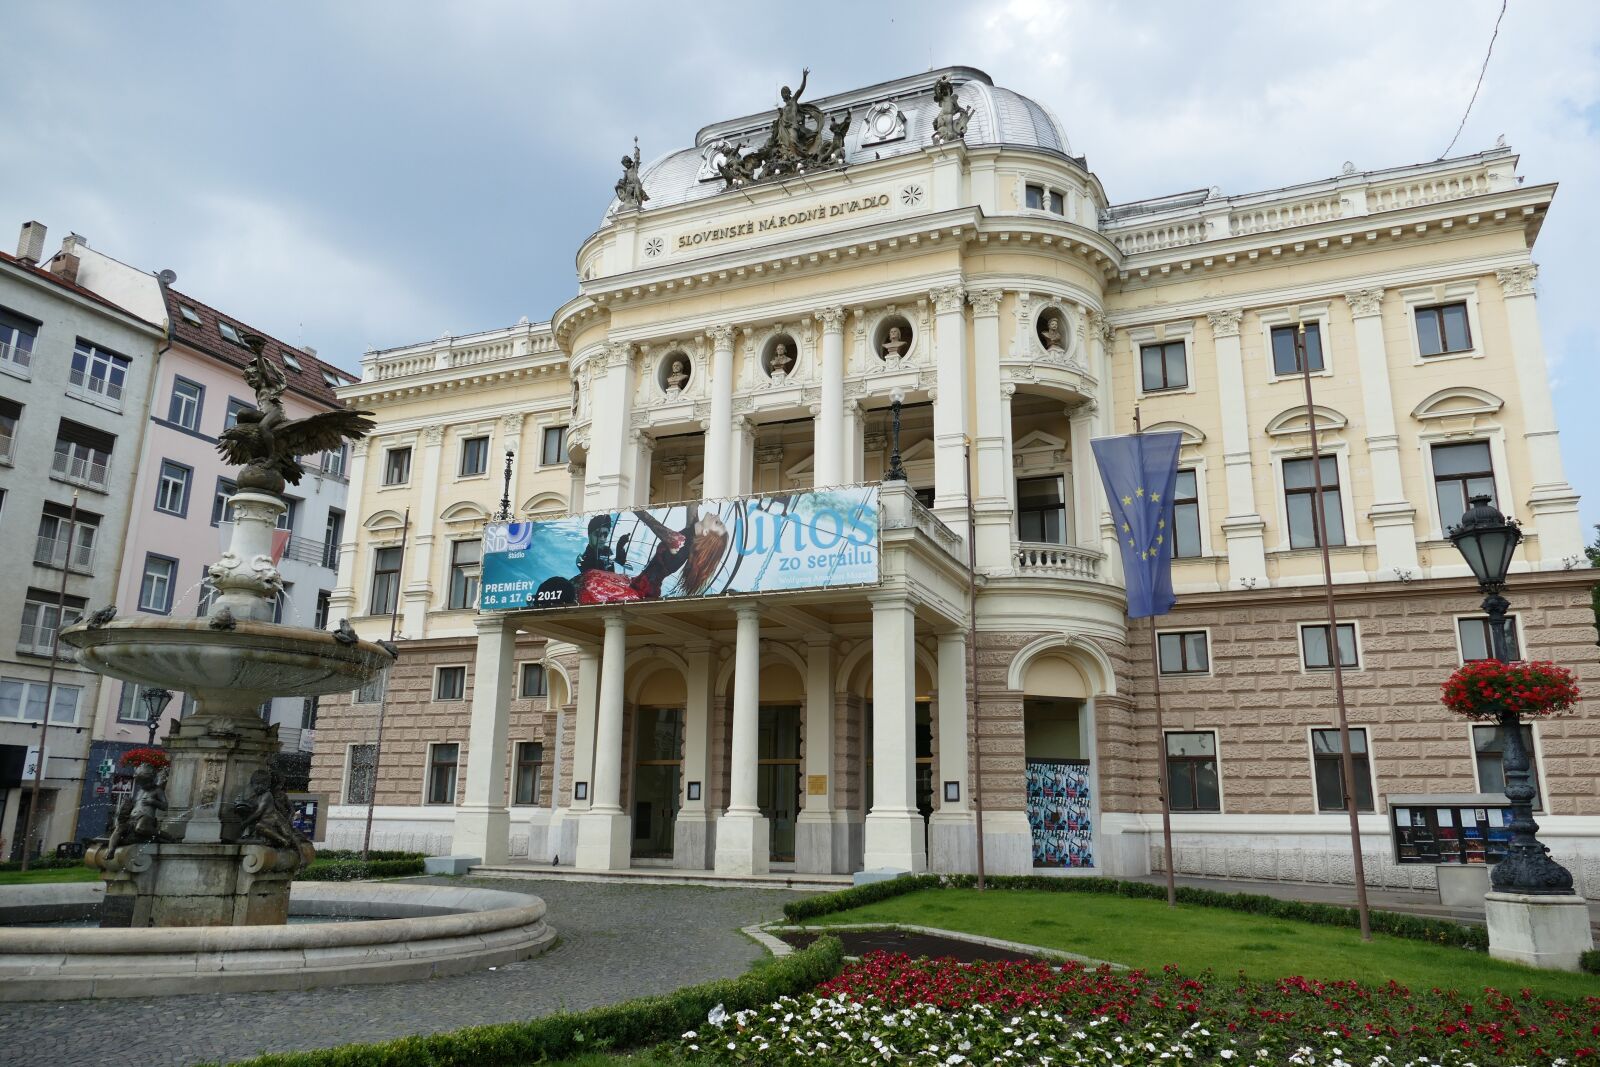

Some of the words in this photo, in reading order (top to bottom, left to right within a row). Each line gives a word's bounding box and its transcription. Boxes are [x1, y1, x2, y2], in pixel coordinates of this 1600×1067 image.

[678, 220, 754, 248] SLOVENSKÉ
[758, 204, 826, 231] NÁRODNÉ
[829, 194, 889, 216] DIVADLO
[779, 556, 801, 571] zo
[807, 549, 872, 569] serailu
[485, 580, 534, 593] PREMIÉRY
[484, 595, 499, 605] 16.
[501, 596, 507, 604] a
[510, 593, 524, 603] 17.
[526, 593, 535, 602] 6.
[538, 590, 563, 601] 2017
